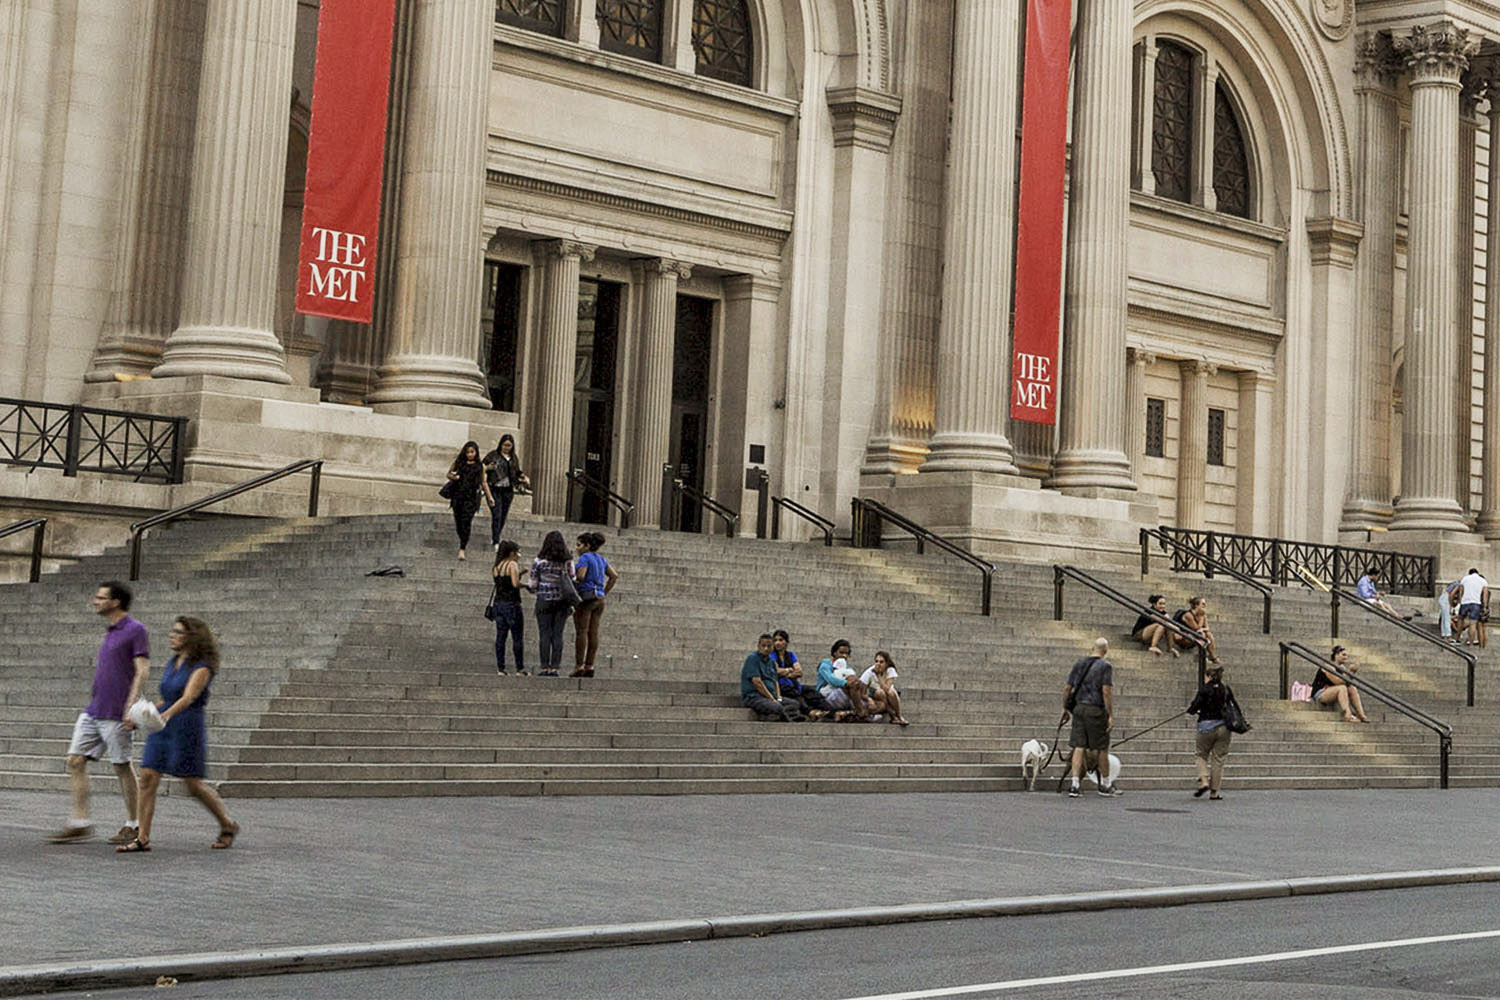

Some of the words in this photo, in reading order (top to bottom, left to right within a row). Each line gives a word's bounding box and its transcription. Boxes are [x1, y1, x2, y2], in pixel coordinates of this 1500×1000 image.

[312, 227, 366, 267] THE
[306, 262, 366, 303] MET
[1017, 352, 1051, 383] THE
[1016, 379, 1052, 410] MET
